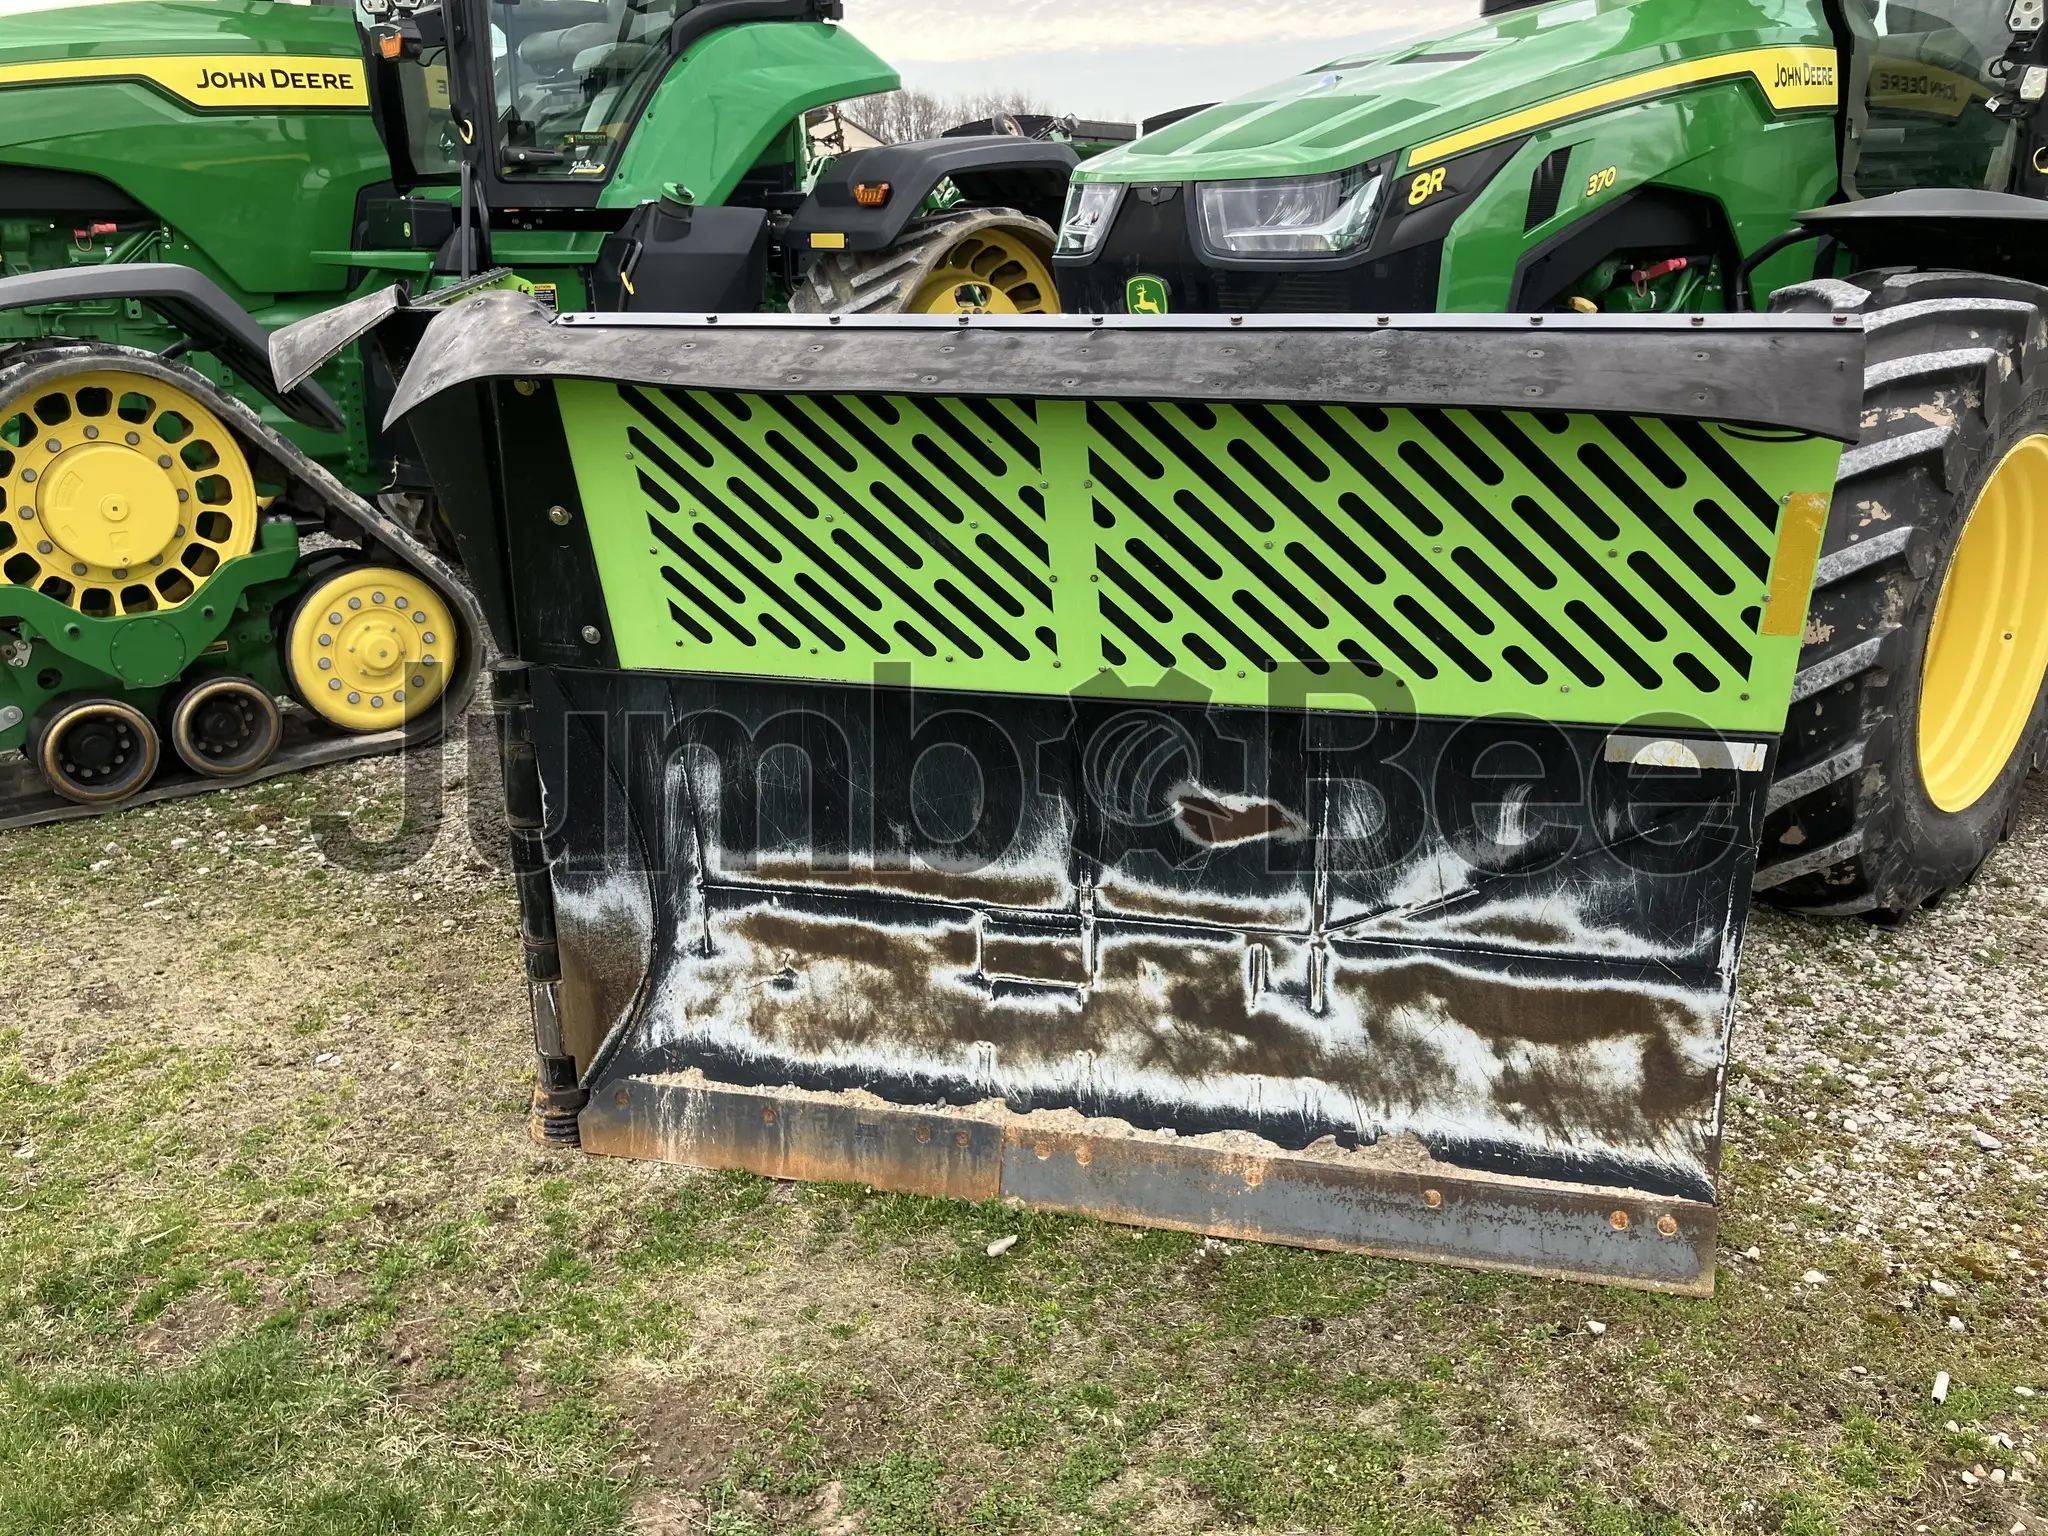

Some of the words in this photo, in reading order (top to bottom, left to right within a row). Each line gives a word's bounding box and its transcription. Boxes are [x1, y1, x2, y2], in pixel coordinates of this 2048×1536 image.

[196, 68, 266, 89] JOHN
[270, 69, 354, 90] DEERE
[1775, 62, 1801, 88] JOHN
[1803, 62, 1833, 86] DEERE
[1408, 166, 1447, 206] 8R
[1586, 165, 1617, 197] 370
